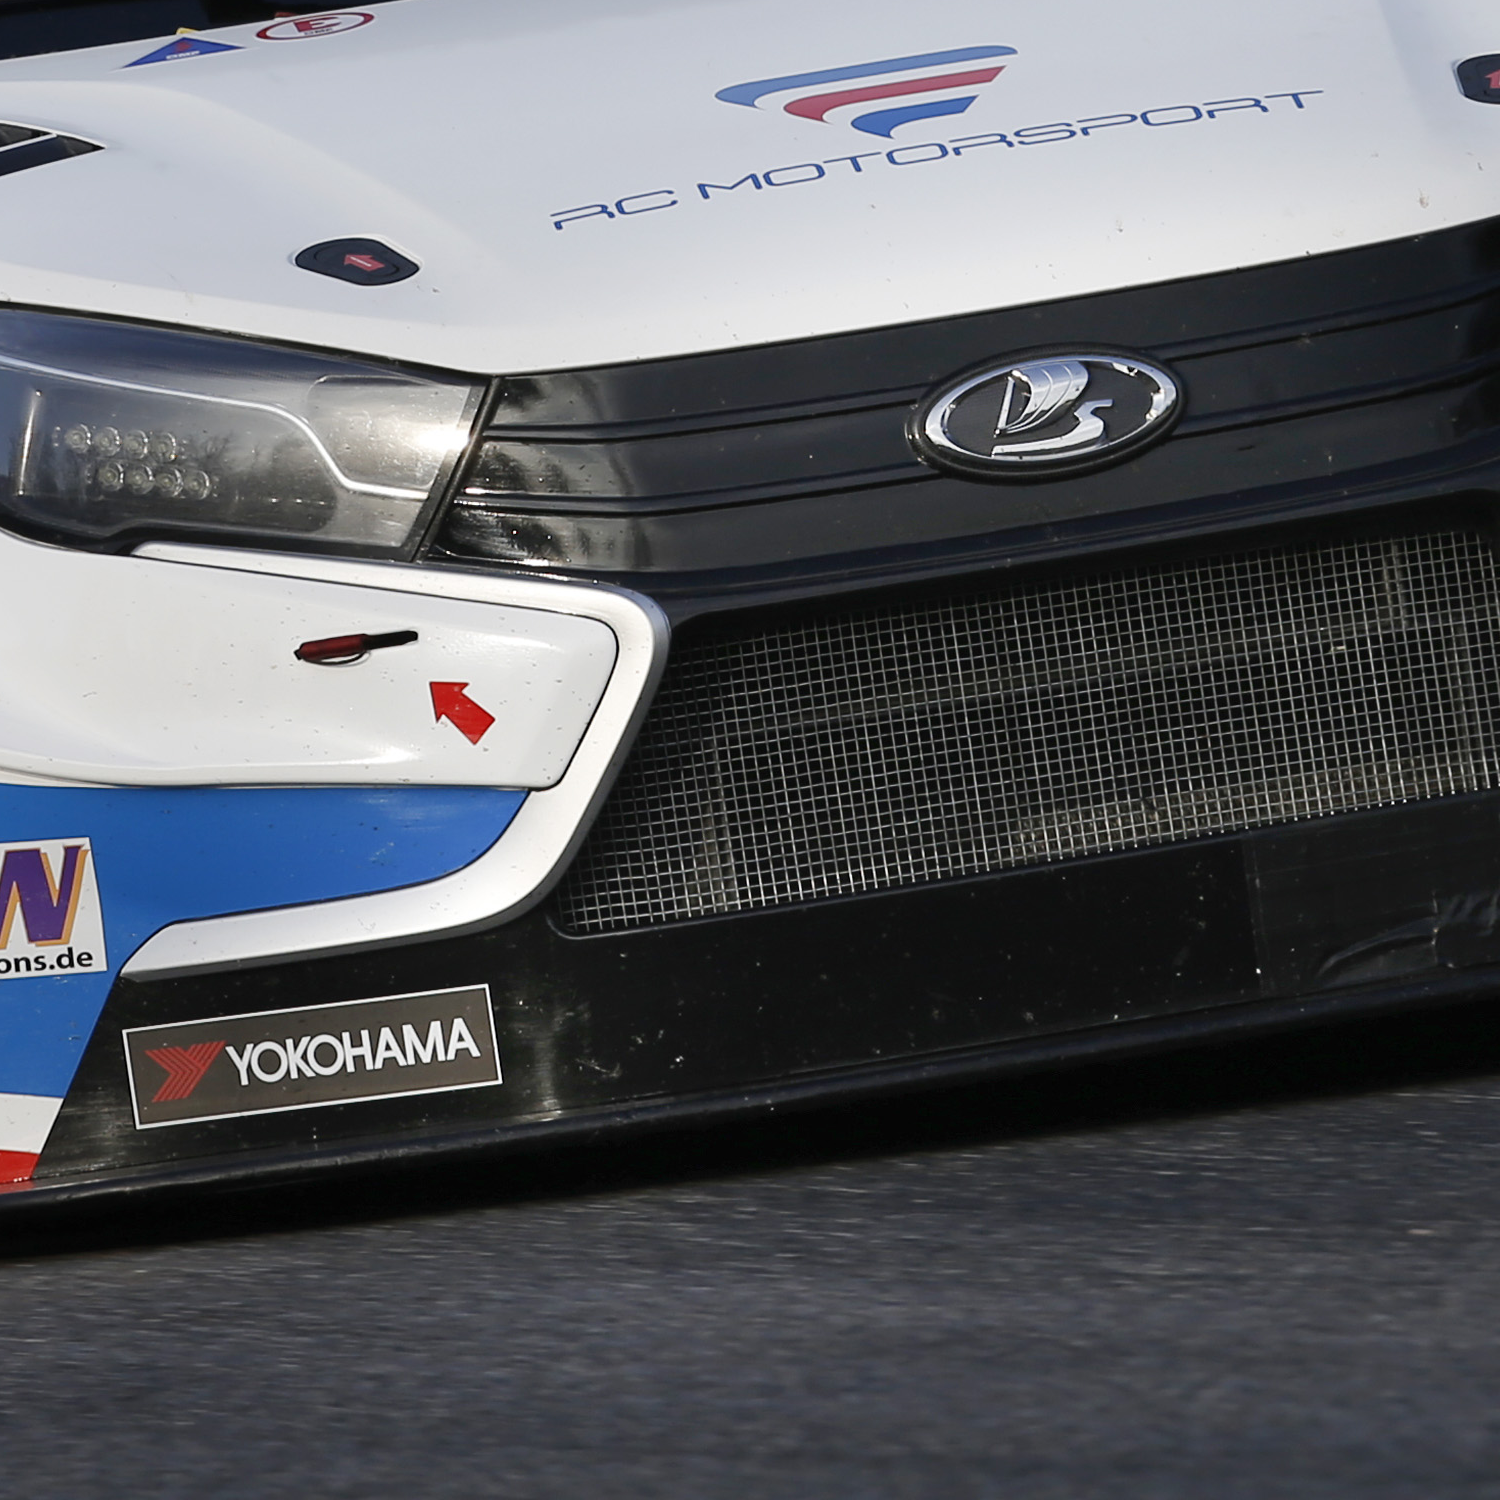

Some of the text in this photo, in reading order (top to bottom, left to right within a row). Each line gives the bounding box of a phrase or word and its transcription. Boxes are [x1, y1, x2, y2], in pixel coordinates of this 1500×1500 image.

[549, 89, 1324, 231] RC MOTORSPORT
[224, 1017, 482, 1086] YOKOHAMA
